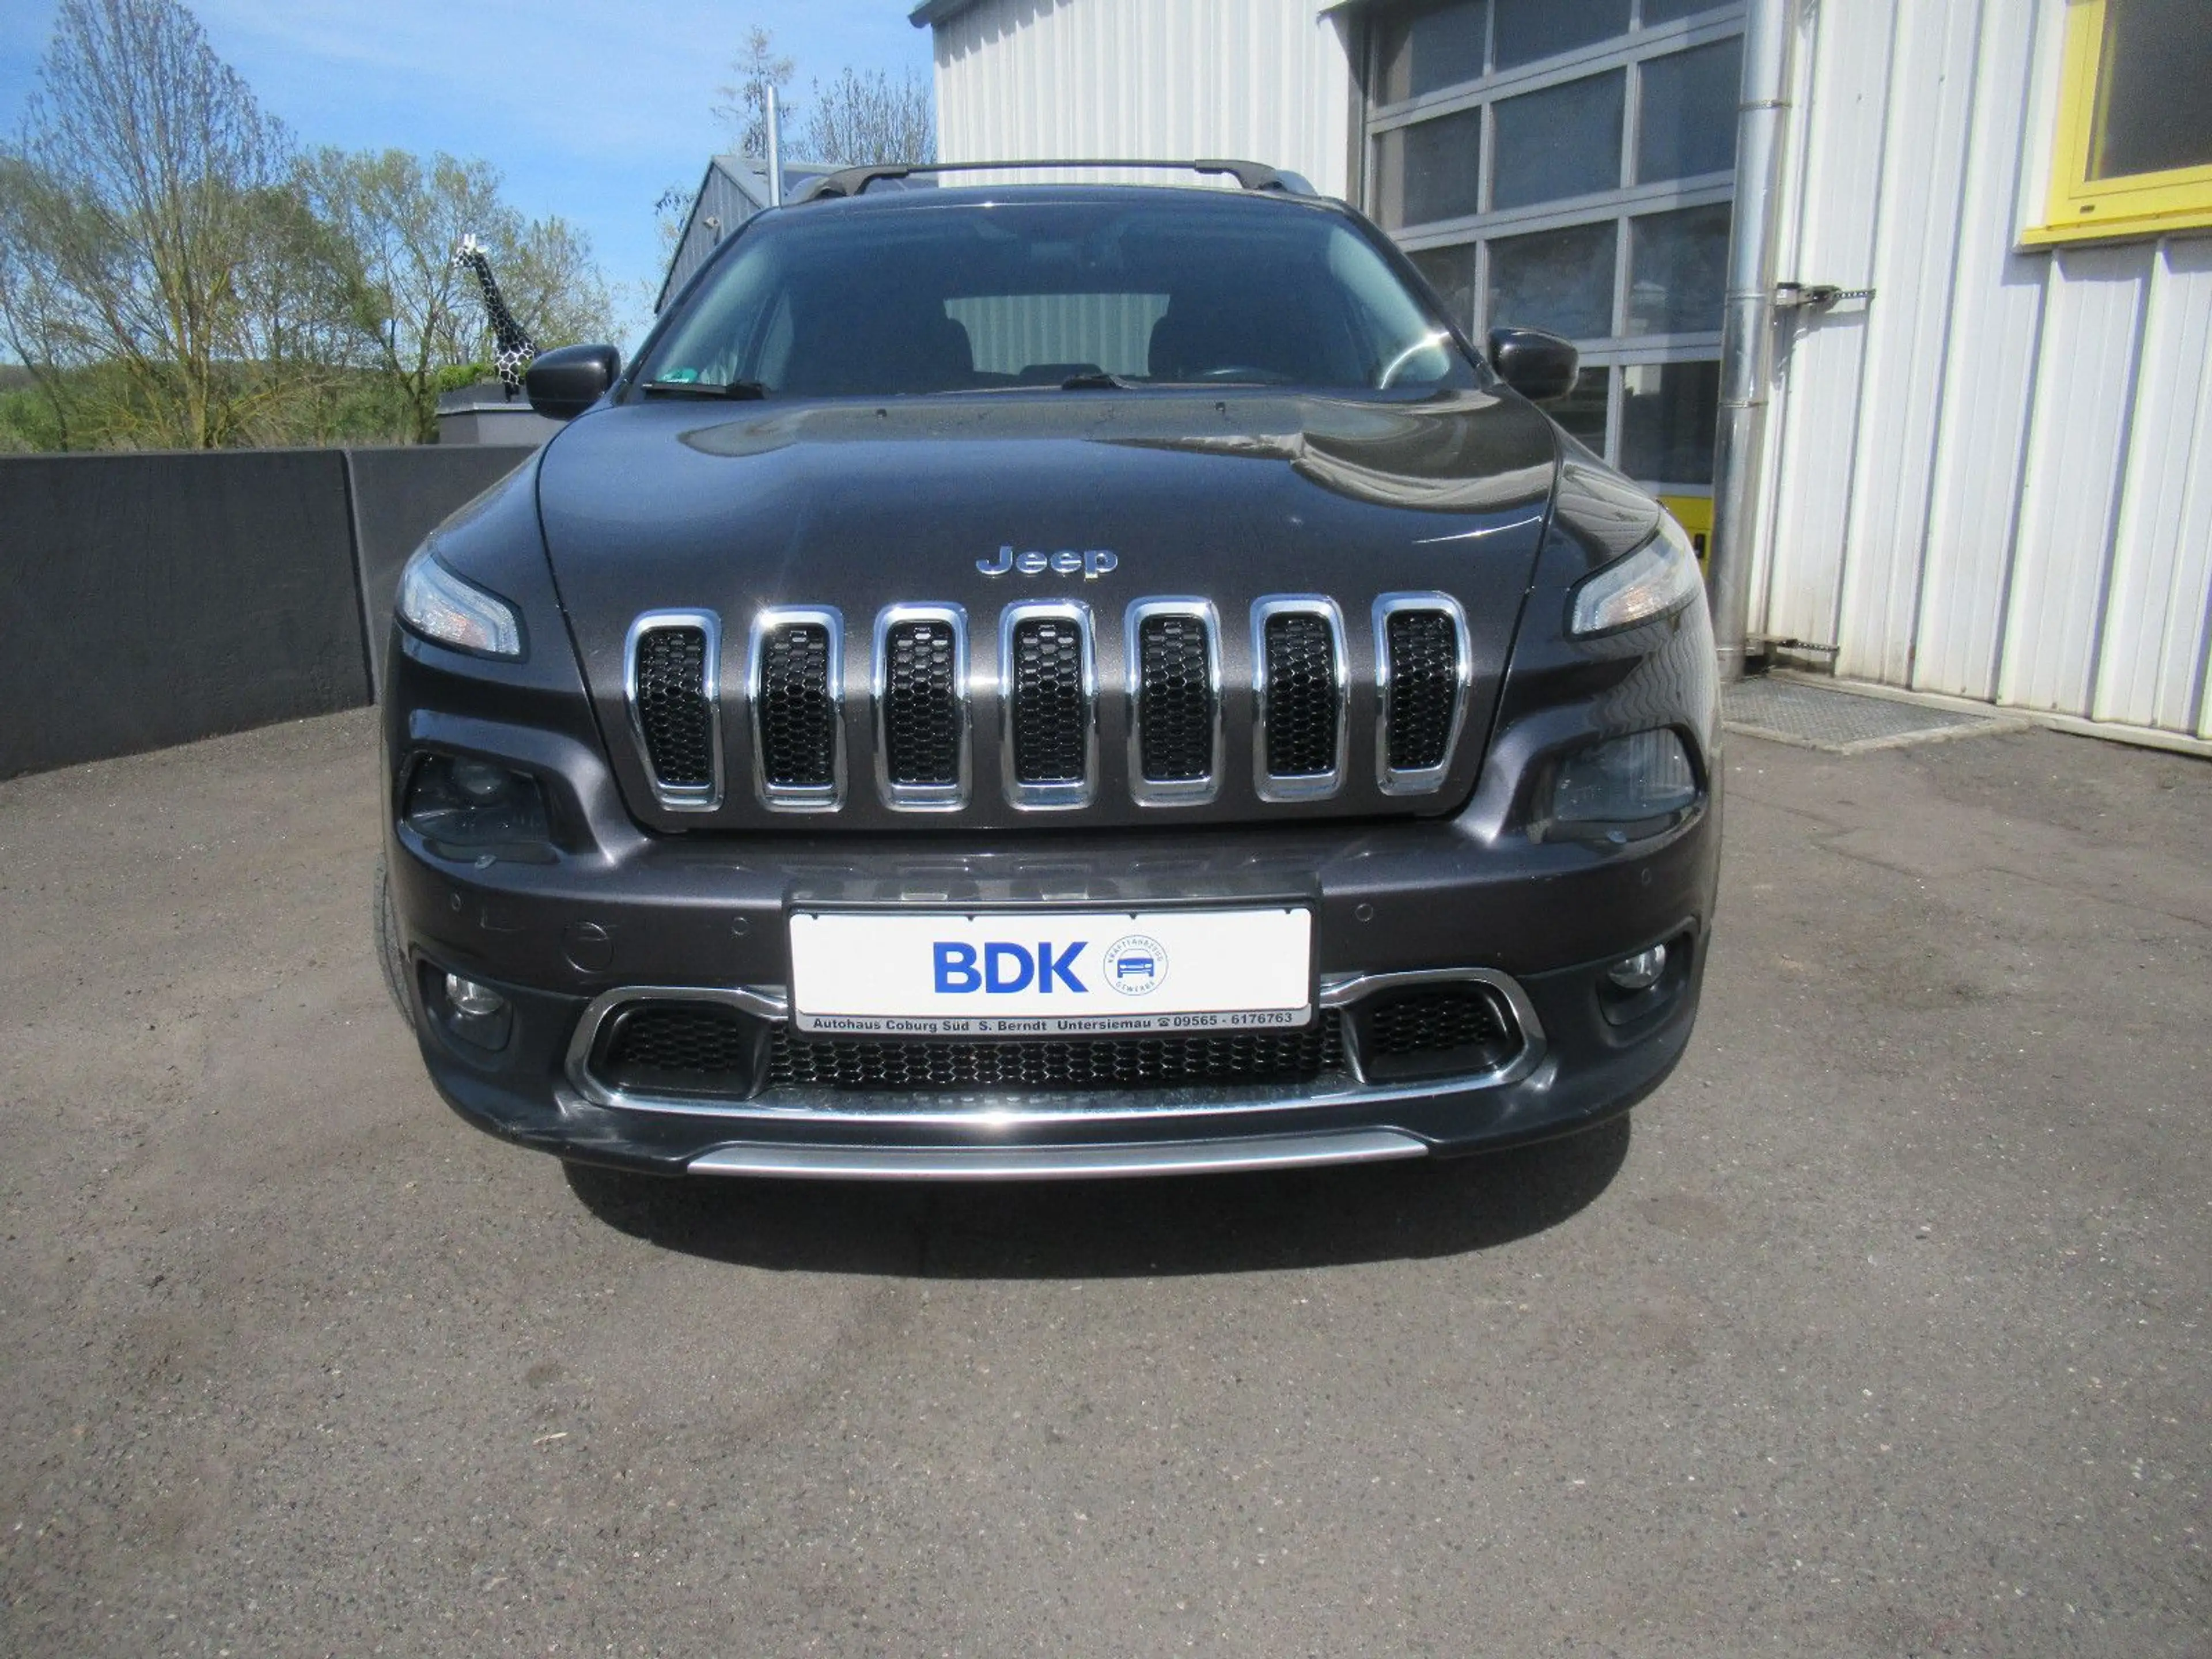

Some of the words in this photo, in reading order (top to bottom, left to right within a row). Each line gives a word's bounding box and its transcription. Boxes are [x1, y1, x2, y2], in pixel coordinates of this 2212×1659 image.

[976, 546, 1118, 579] Jeep
[933, 942, 1089, 993] BDK
[813, 1018, 881, 1029] Autohaus
[886, 1020, 937, 1033] Coburg
[942, 1020, 969, 1031] Süd
[979, 1020, 993, 1031] S.
[998, 1020, 1047, 1031] Berndt
[1057, 1018, 1151, 1031] Untersiemau
[1173, 1016, 1217, 1027] 09565
[1231, 1012, 1292, 1025] 6176763
